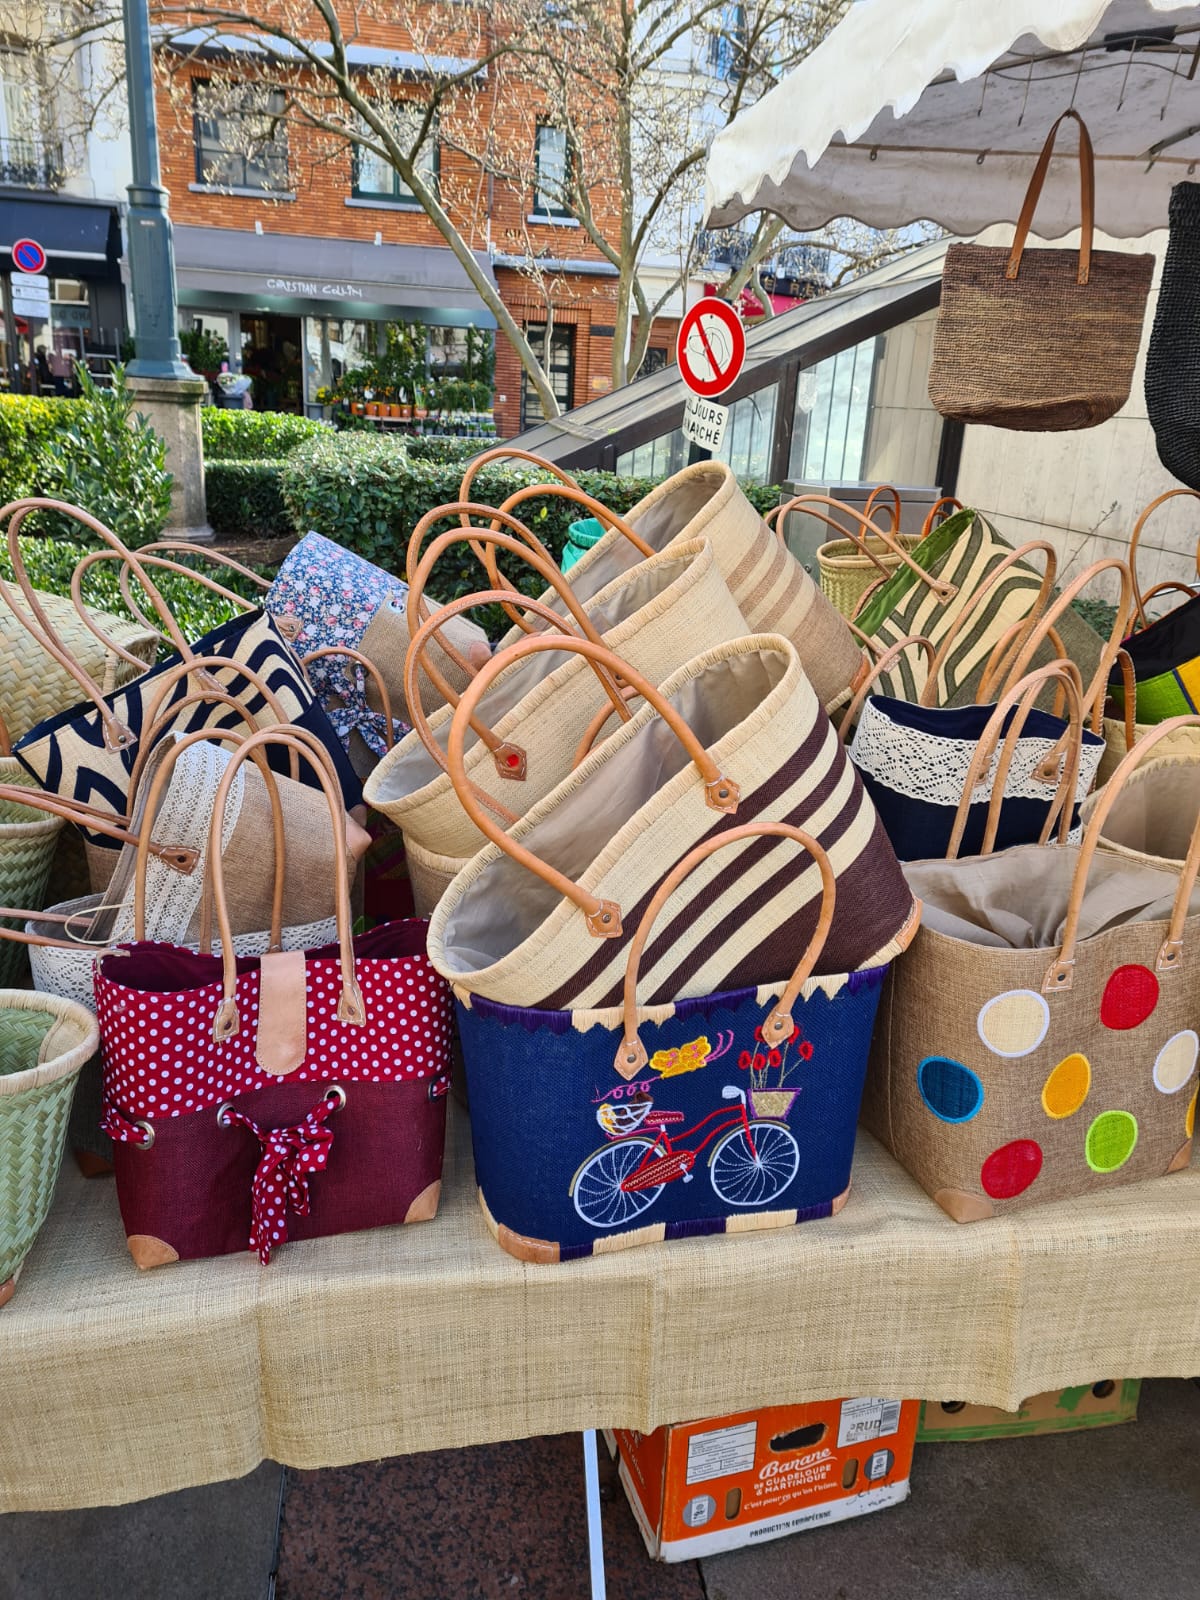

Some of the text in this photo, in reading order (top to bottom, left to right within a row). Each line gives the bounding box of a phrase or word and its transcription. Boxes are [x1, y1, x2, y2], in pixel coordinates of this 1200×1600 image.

[758, 1448, 837, 1480] Banane
[765, 1472, 827, 1494] MARTINIQUE
[766, 1464, 832, 1487] GUADELOUPE
[750, 1522, 790, 1537] PRODUCTION
